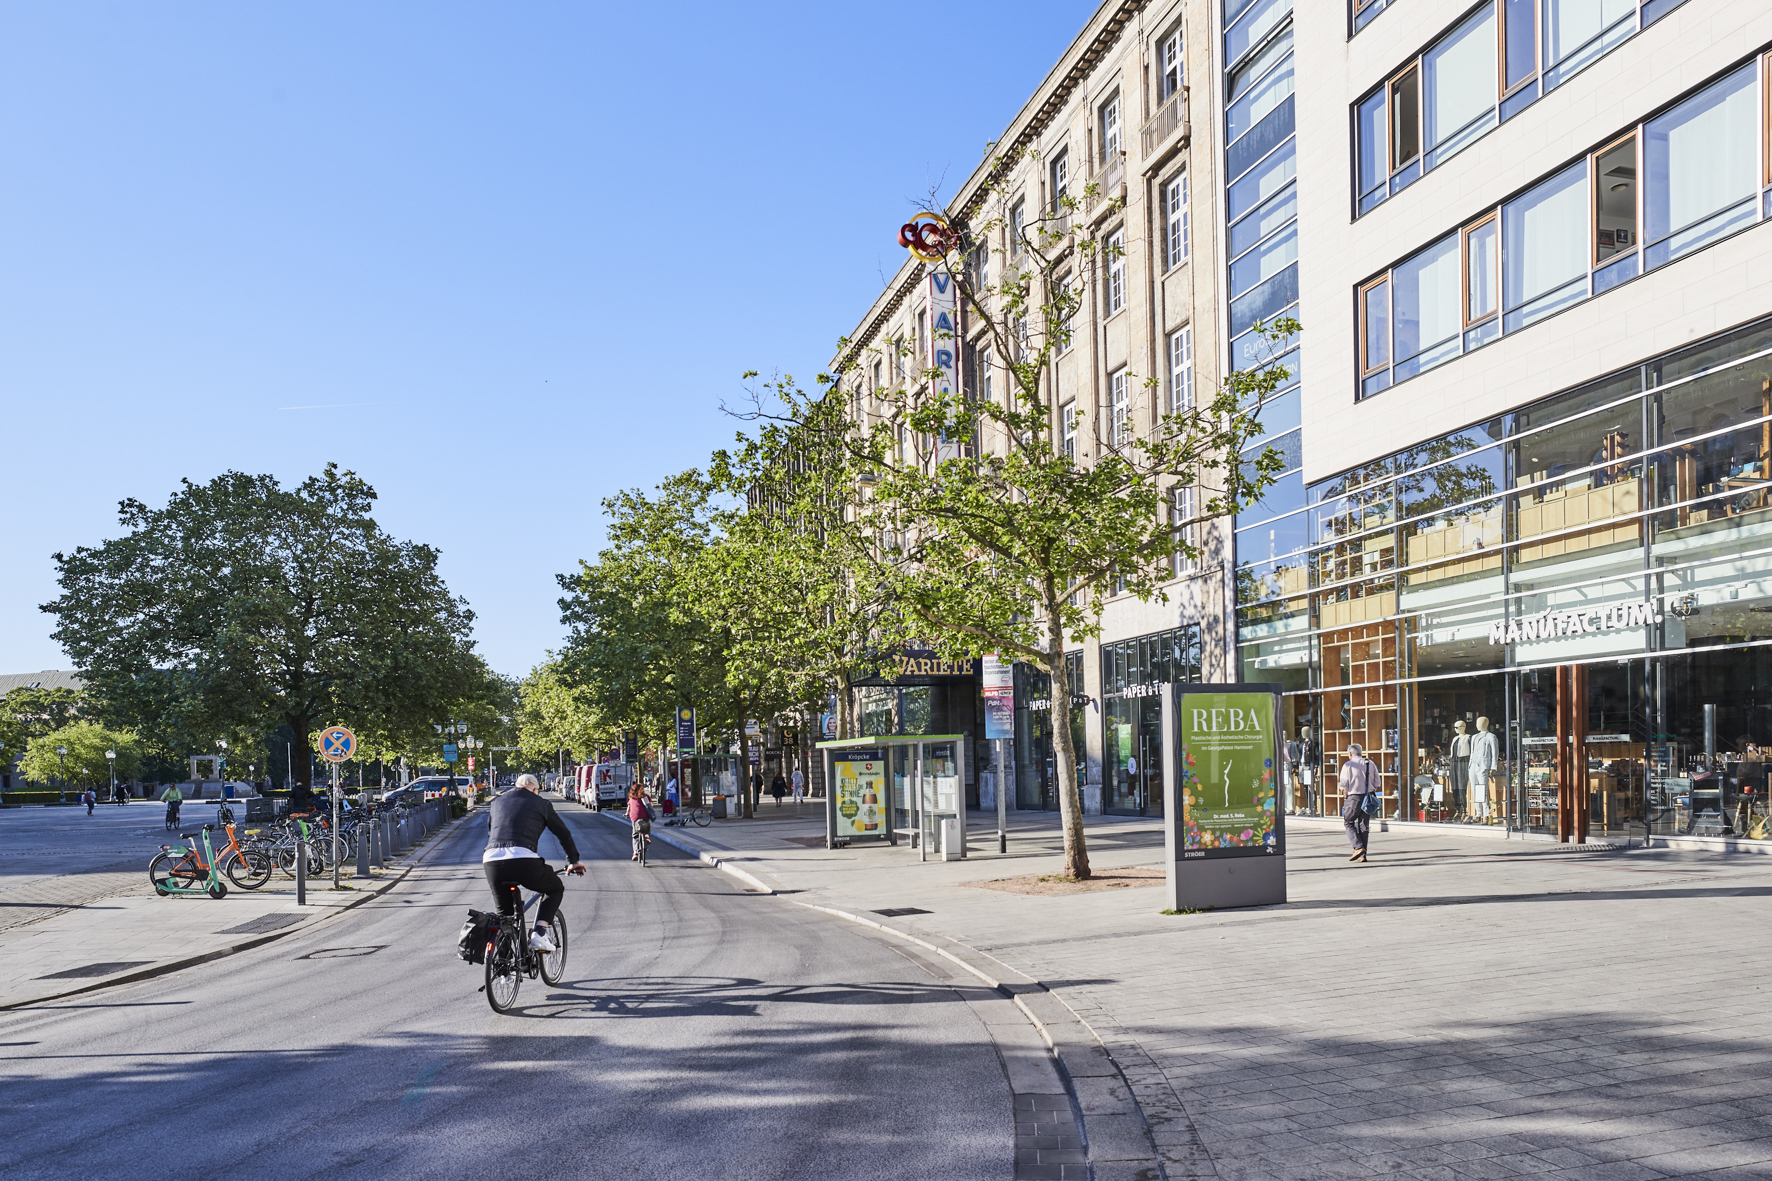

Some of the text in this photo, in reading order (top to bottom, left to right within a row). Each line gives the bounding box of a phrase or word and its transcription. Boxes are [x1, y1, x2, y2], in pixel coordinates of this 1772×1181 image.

[1122, 684, 1147, 699] PAPER
[1029, 699, 1046, 711] PAPER
[1191, 708, 1263, 732] REBA
[783, 737, 794, 745] 38
